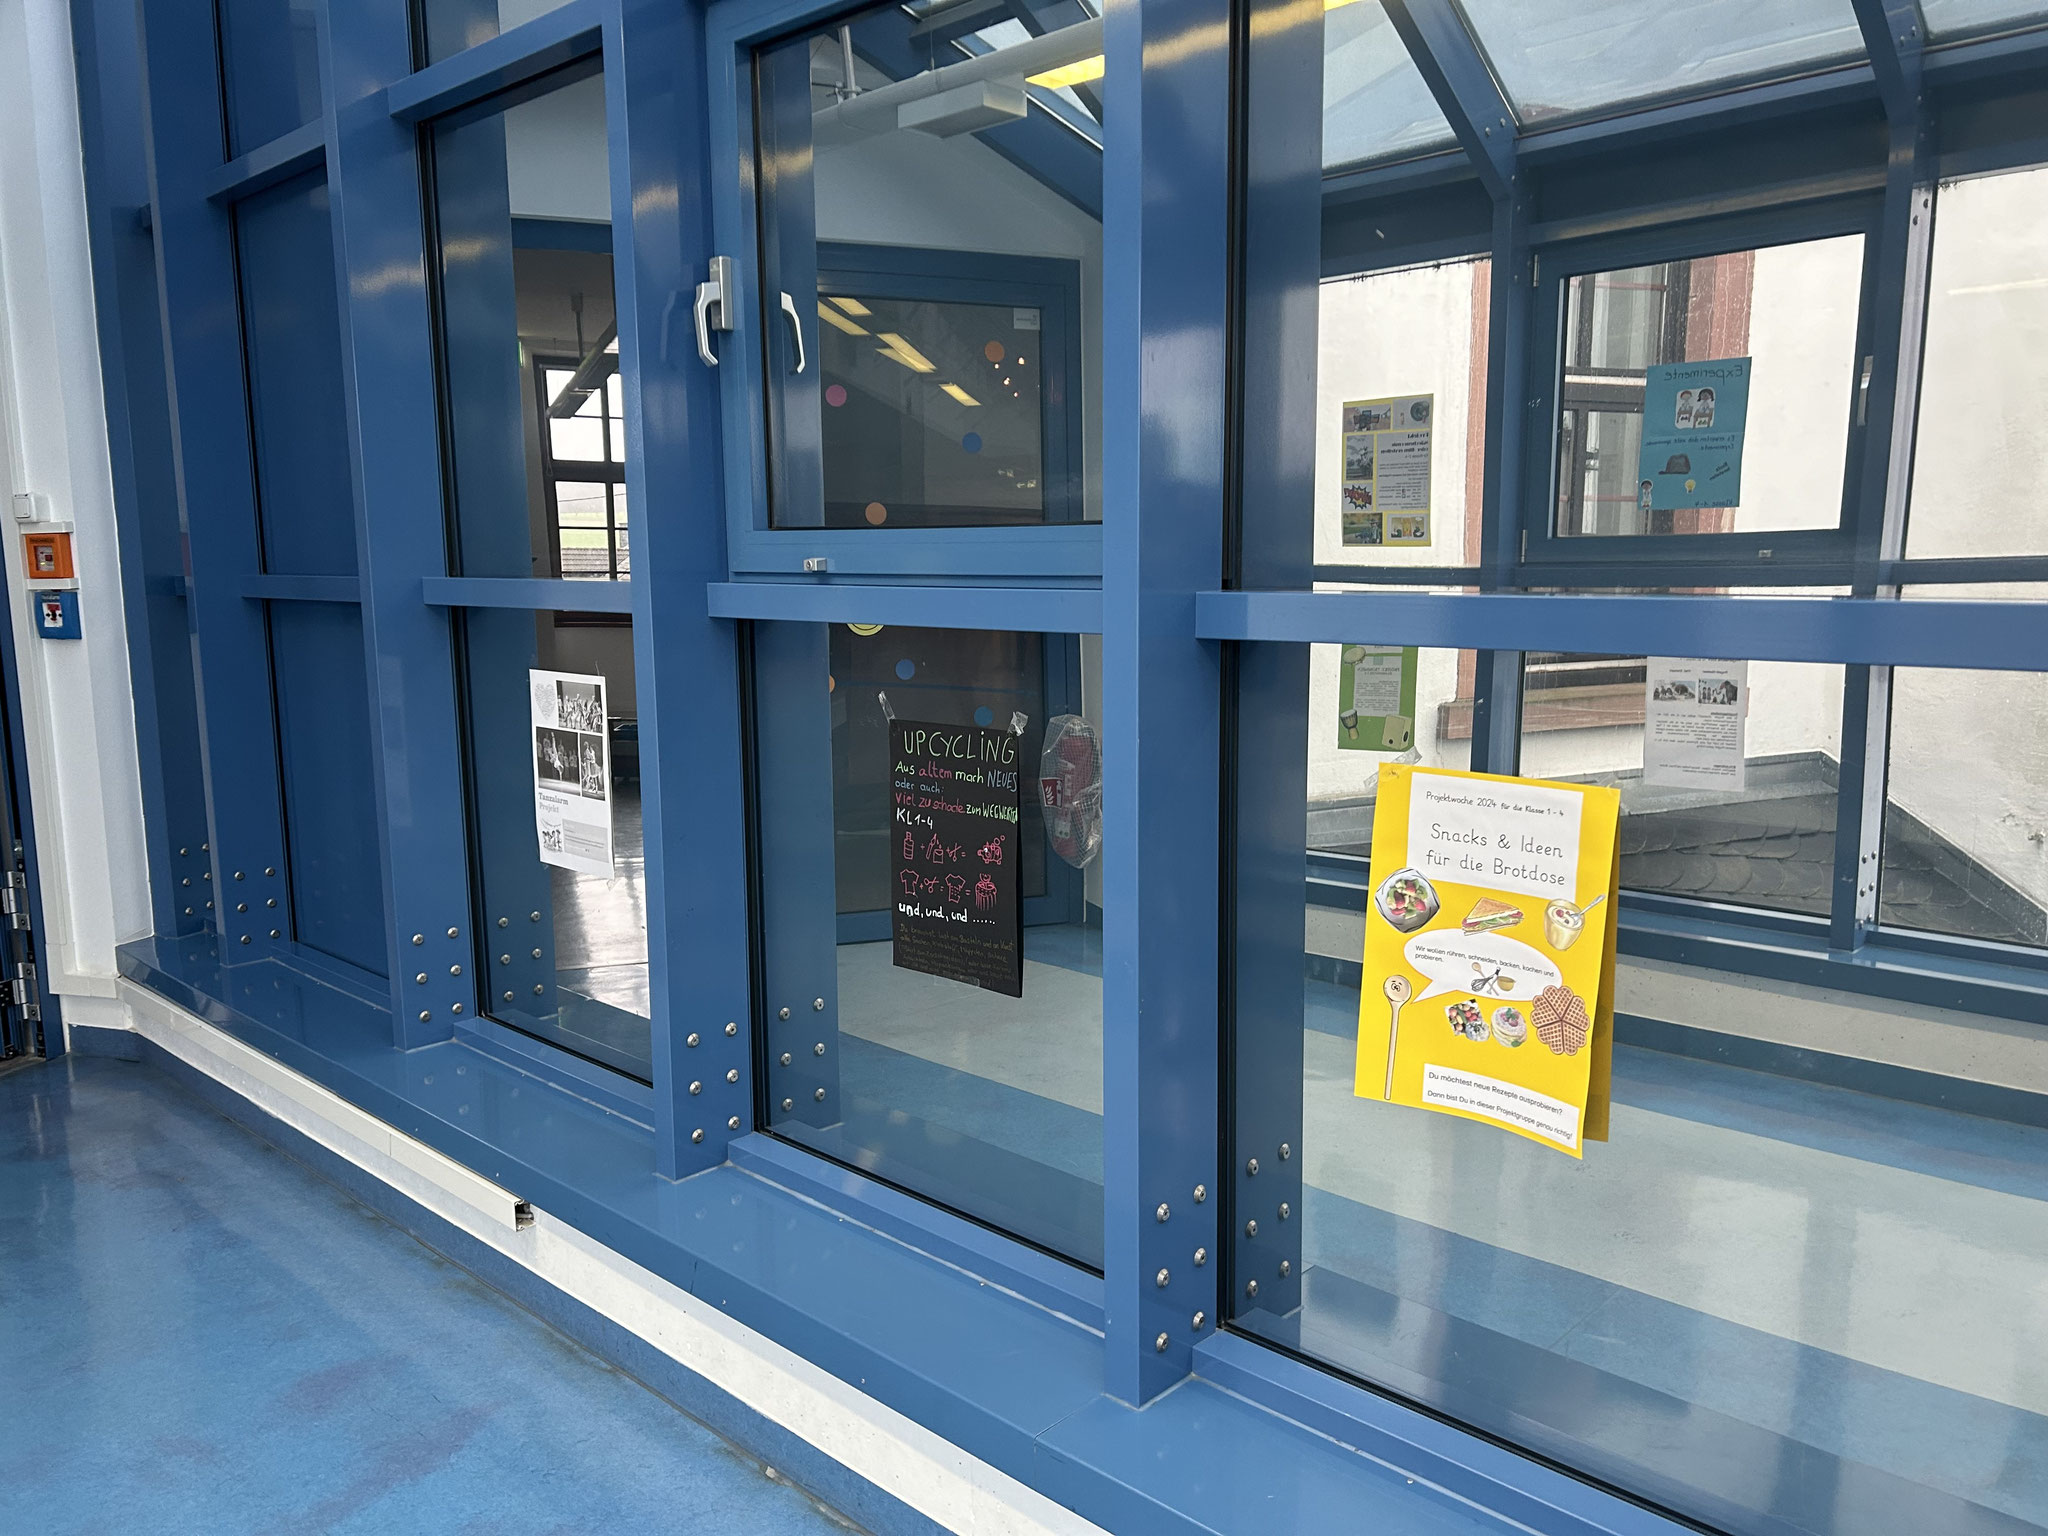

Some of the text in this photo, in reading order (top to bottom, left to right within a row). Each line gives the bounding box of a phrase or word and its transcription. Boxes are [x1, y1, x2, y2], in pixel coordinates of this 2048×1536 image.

[895, 760, 1017, 793] Aus altem mach NEUES
[895, 777, 945, 794] oder auch:
[1426, 790, 1474, 805] Projektwoche
[1477, 797, 1497, 808] 2024
[1501, 802, 1511, 810] für
[1513, 803, 1523, 812] die
[1525, 805, 1545, 815] Klasse
[1430, 822, 1563, 858] Snacks & Ideen
[1426, 849, 1565, 886] für die Brotdose
[951, 908, 968, 923] und
[1415, 952, 1443, 963] probieren.
[1427, 947, 1445, 955] wollen
[1446, 949, 1467, 959] rühren,
[1468, 954, 1498, 965] schneiden,
[1522, 964, 1543, 974] kochen
[1543, 970, 1555, 978] und
[1428, 1071, 1563, 1115] Du möchtest neue Rezepte ausprobieren?
[1427, 1090, 1573, 1140] Dann bist Du in dieser Projektgruppe genau richtig!
